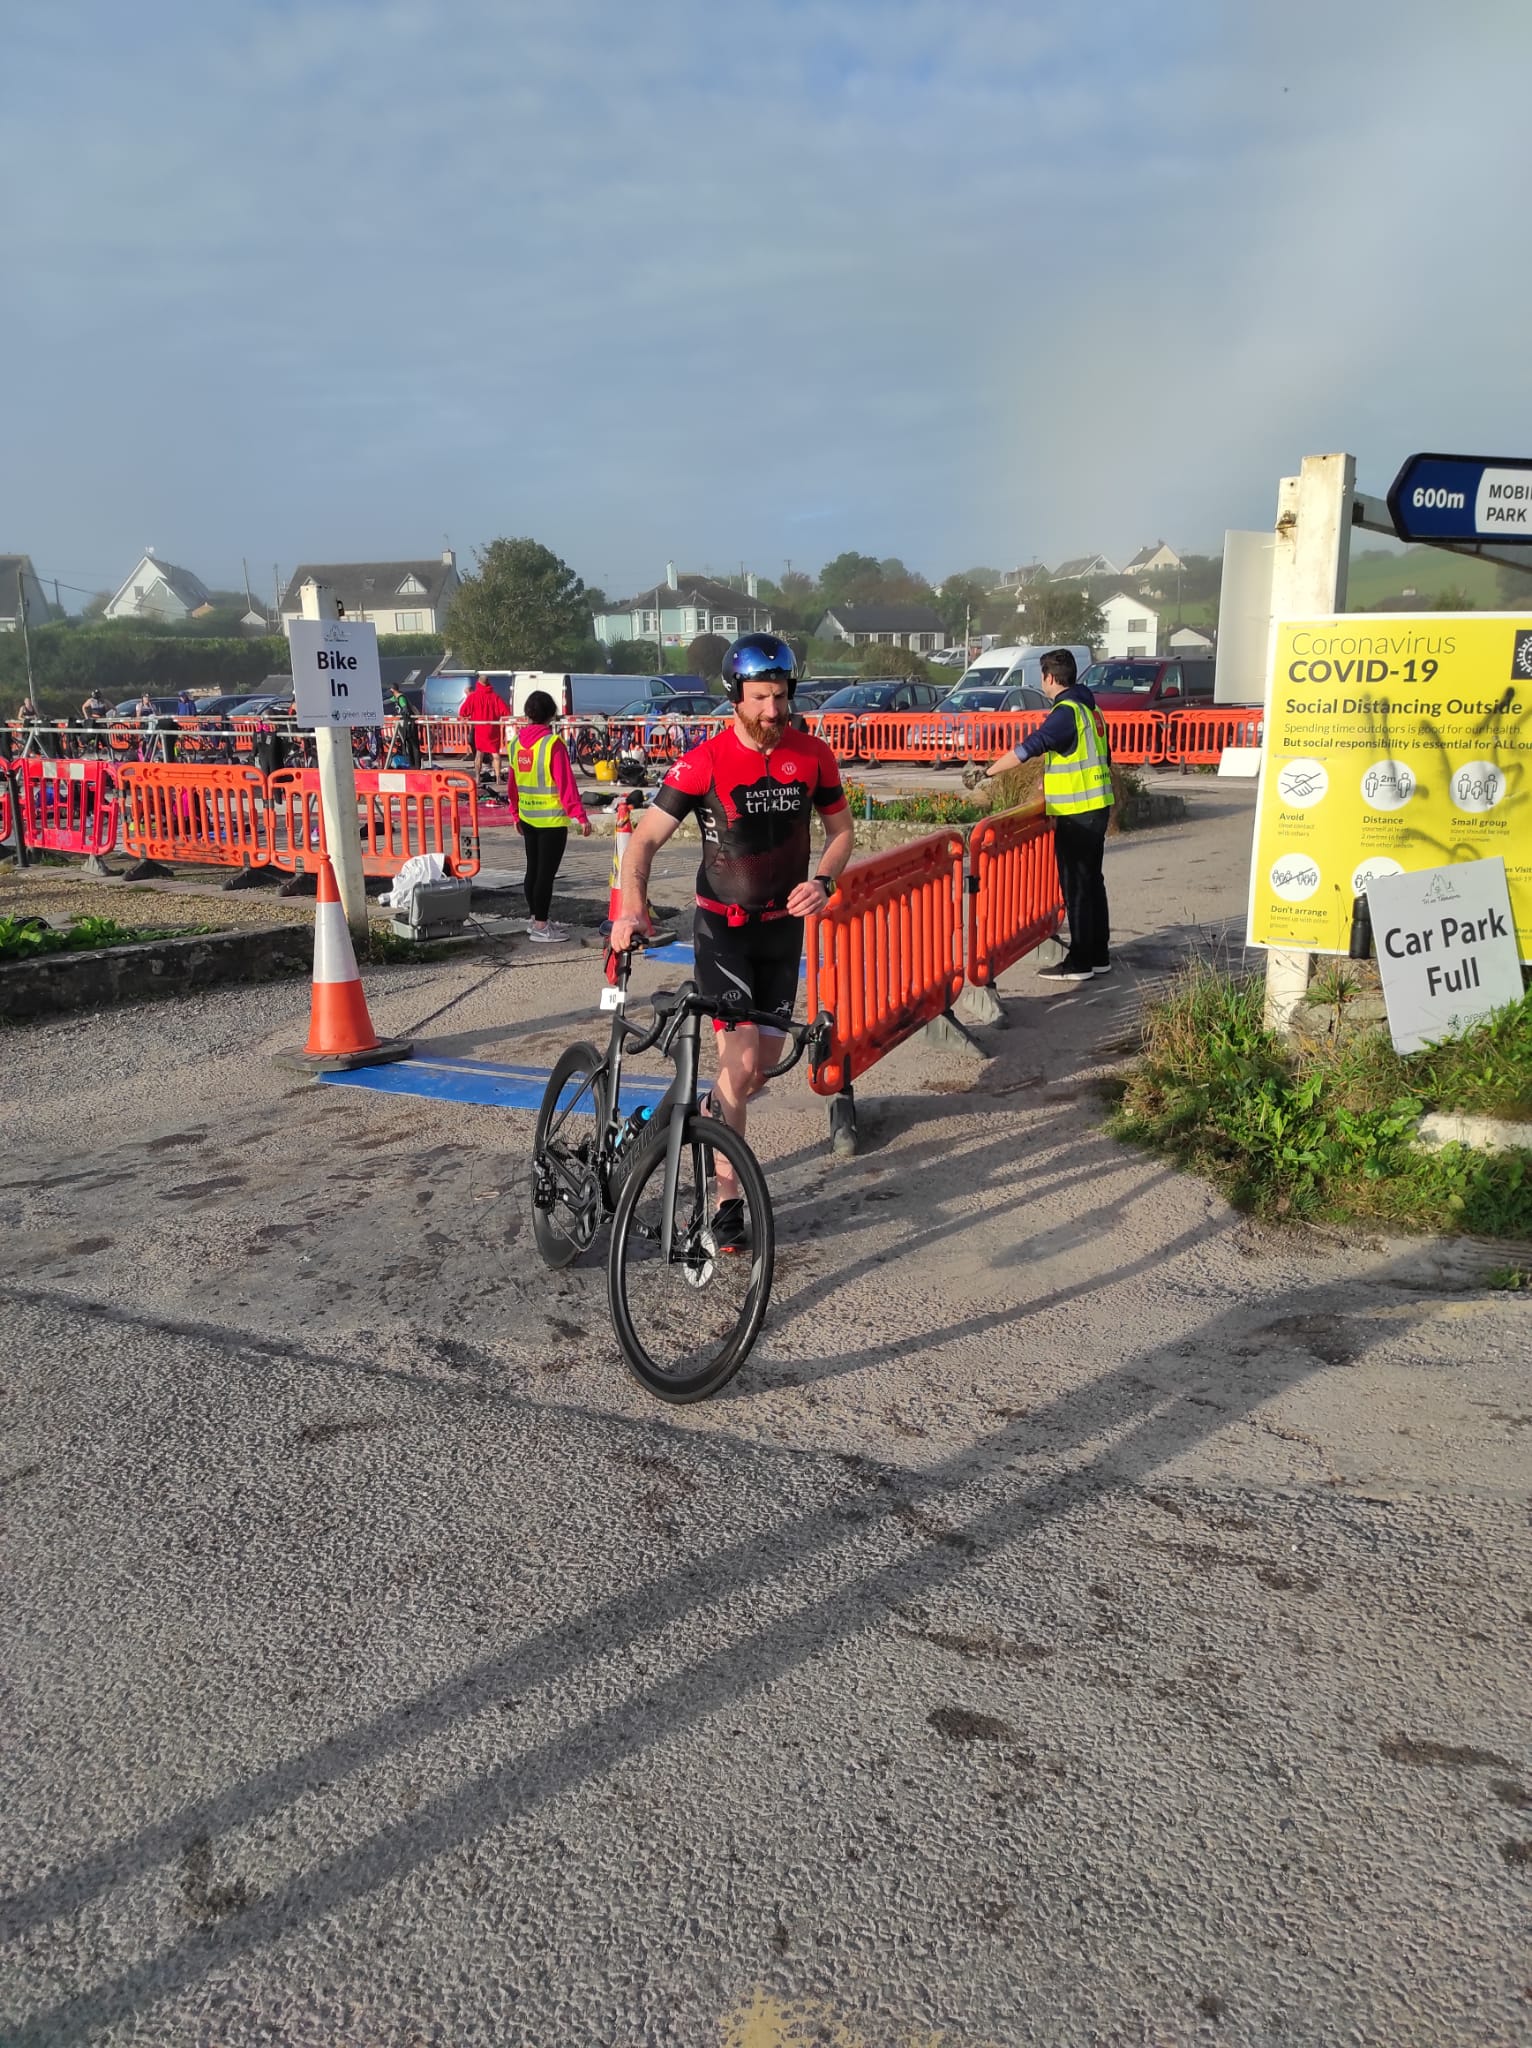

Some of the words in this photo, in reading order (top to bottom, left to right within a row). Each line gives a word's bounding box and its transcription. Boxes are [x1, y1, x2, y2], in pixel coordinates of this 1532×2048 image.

[1412, 488, 1465, 509] 600m
[1489, 484, 1532, 500] MOBI
[1486, 507, 1528, 522] PARK
[1292, 631, 1456, 655] Coronavirus
[317, 650, 358, 670] Bike
[1288, 659, 1439, 684] COVID-19
[330, 679, 349, 697] In
[1286, 699, 1338, 714] Social
[1343, 699, 1442, 717] Distancing
[1447, 699, 1523, 715] Outside
[1284, 723, 1330, 735] Spending
[1332, 724, 1355, 733] time
[1358, 723, 1406, 734] outdoors
[1408, 725, 1417, 733] is
[1418, 724, 1444, 735] good
[1447, 725, 1463, 733] for
[1283, 738, 1301, 748] But
[1303, 738, 1333, 748] social
[1335, 739, 1409, 750] responsibility
[1412, 740, 1420, 749] is
[1422, 740, 1471, 749] essential
[1474, 740, 1490, 749] for
[1494, 740, 1516, 750] ALL
[1518, 742, 1532, 750] ou
[1380, 775, 1397, 783] 2m
[746, 790, 770, 799] EAST
[772, 786, 801, 797] CORK
[1279, 812, 1305, 821] Avoid
[1363, 815, 1404, 825] Distance
[1451, 817, 1477, 826] Small
[1479, 819, 1508, 829] group
[1270, 905, 1294, 915] Don't
[1295, 908, 1328, 917] arrange
[1384, 927, 1434, 959] Car
[1440, 908, 1508, 948] Park
[1426, 957, 1480, 997] Full
